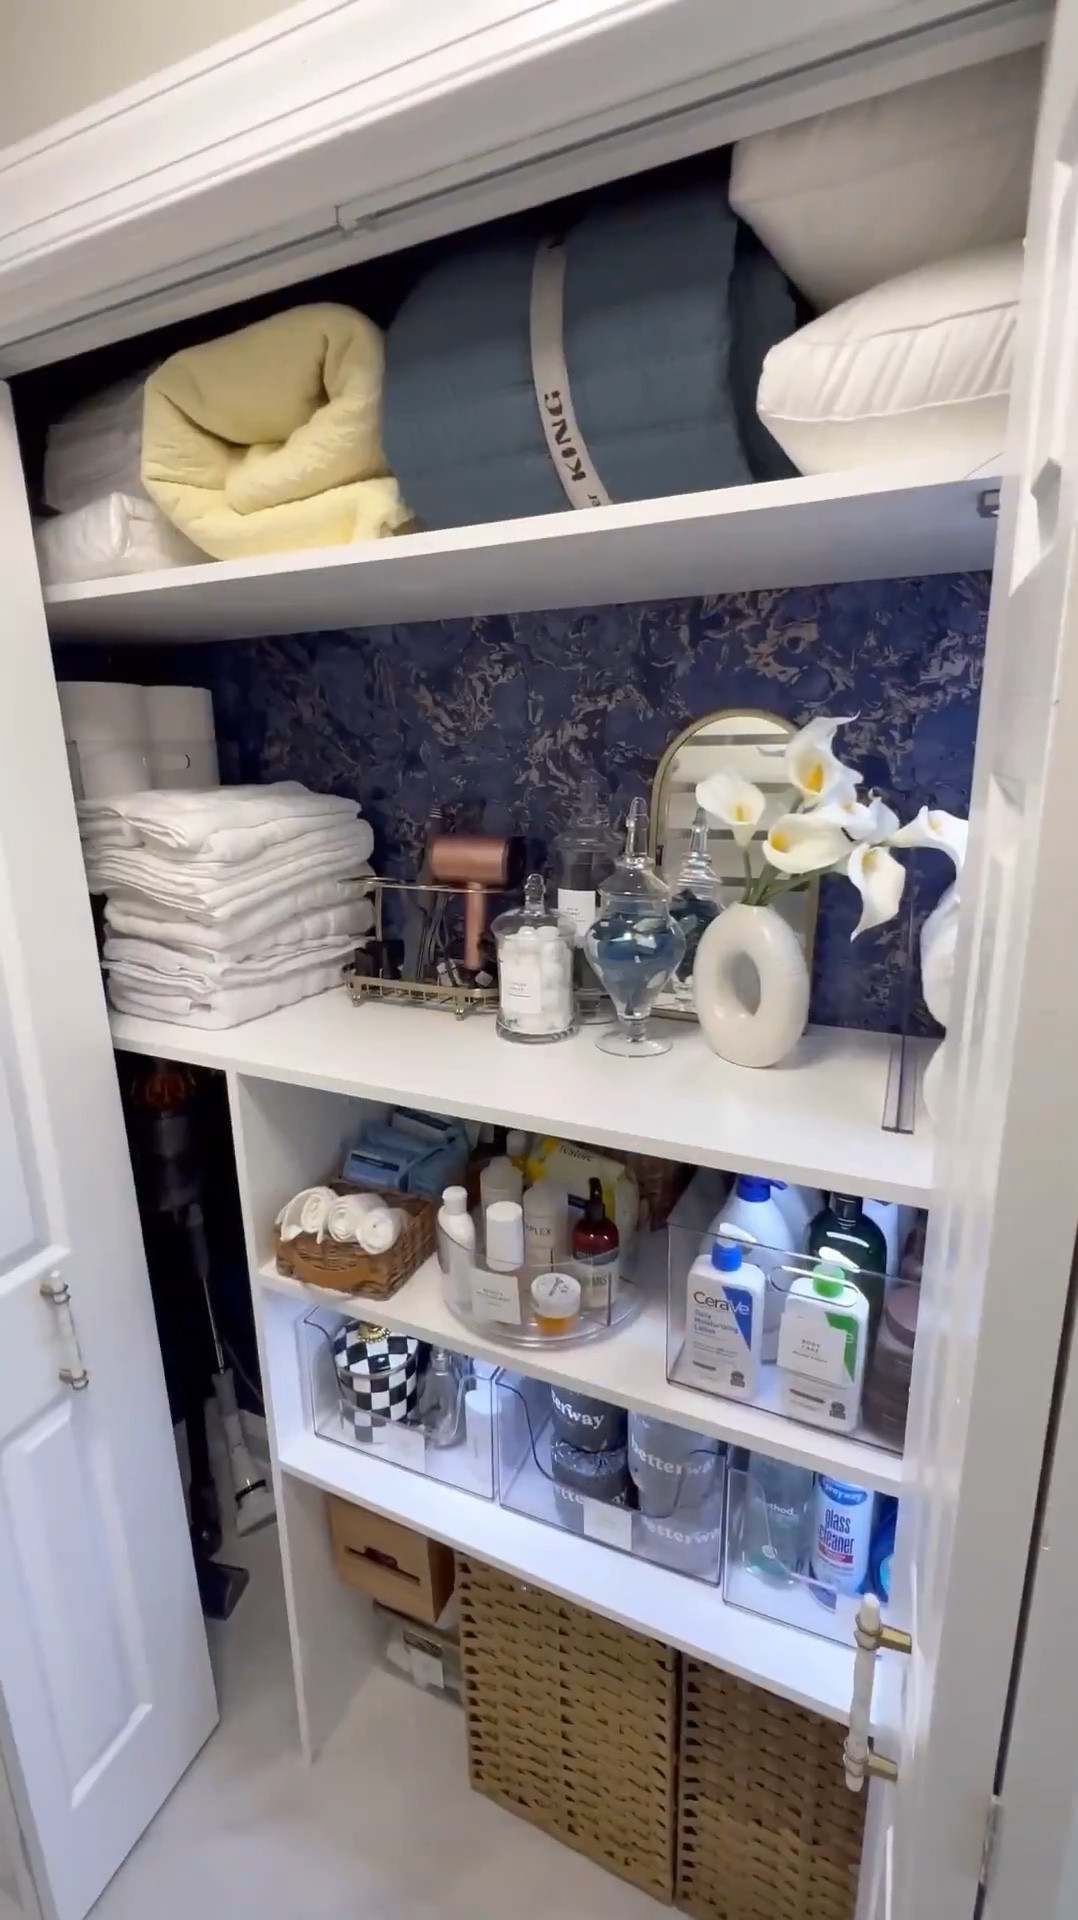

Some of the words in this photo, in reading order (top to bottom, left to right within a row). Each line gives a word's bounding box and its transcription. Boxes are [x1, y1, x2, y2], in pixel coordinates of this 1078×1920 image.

[544, 389, 586, 482] KING
[693, 1290, 750, 1316] CeraVe
[825, 1508, 852, 1535] glass
[819, 1524, 856, 1555] cleaner
